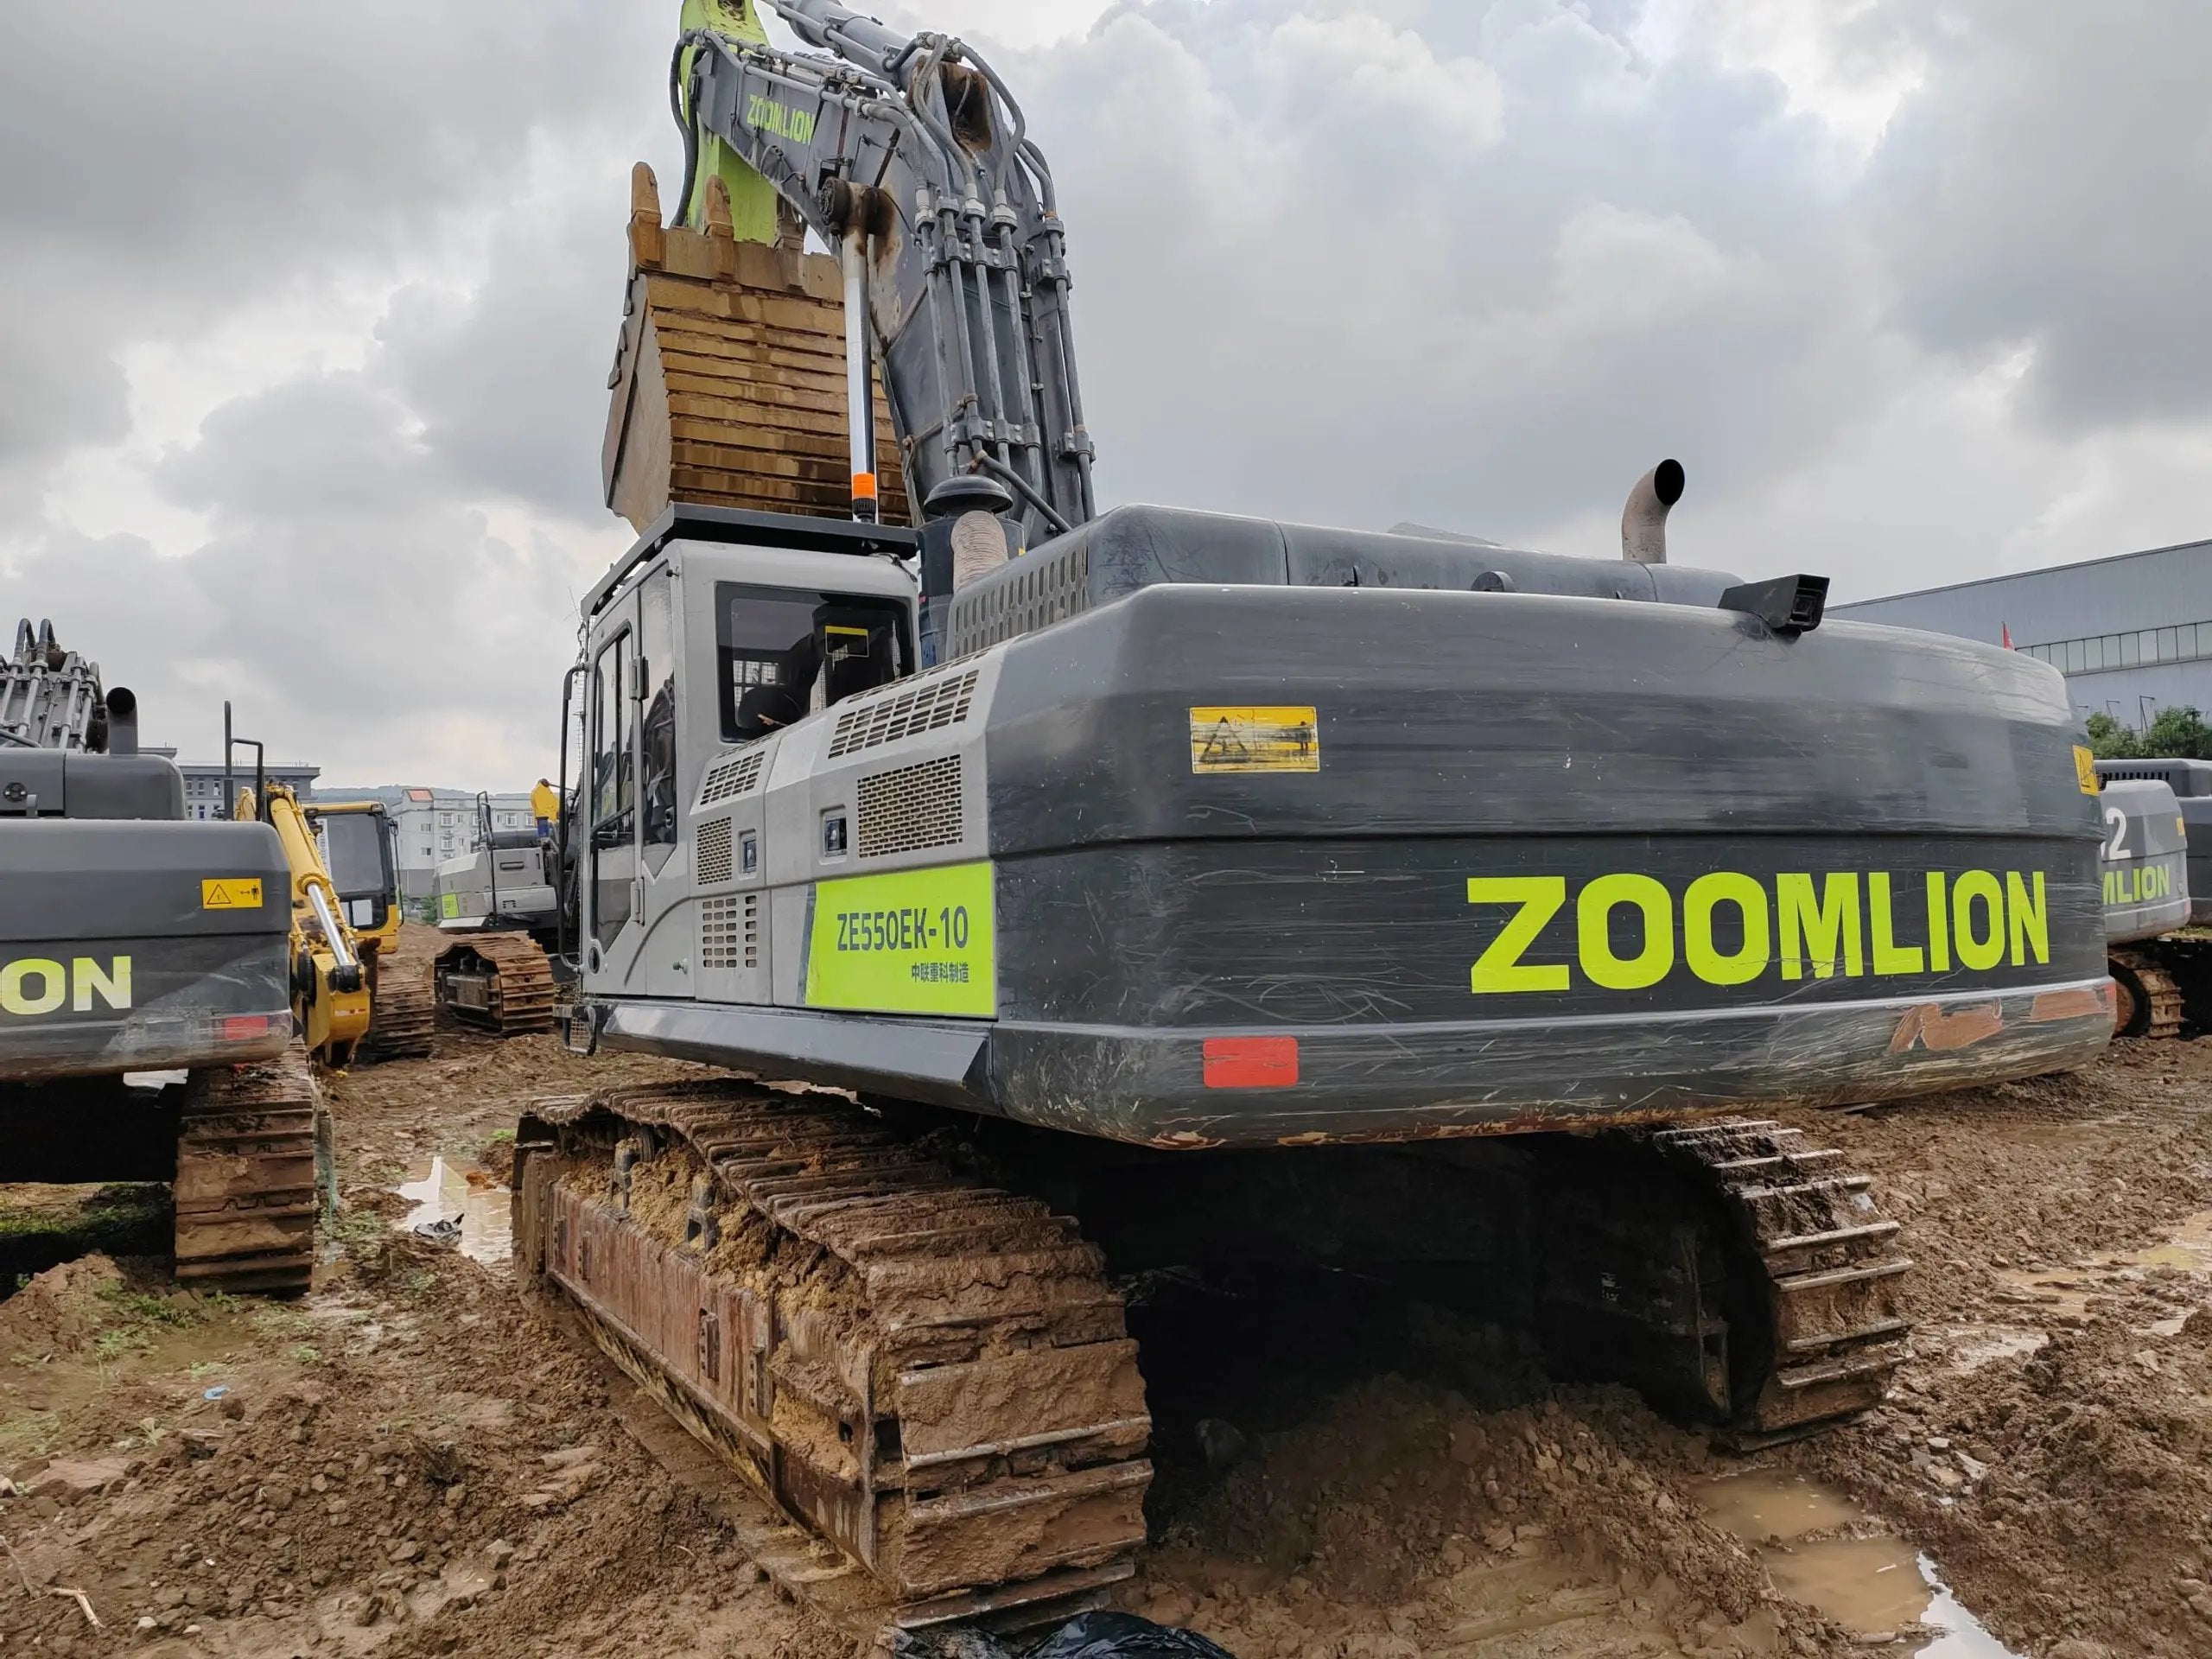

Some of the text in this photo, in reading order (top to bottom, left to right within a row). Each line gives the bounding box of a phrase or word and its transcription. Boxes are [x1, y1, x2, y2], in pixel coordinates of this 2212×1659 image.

[747, 93, 816, 146] ZOOMLION
[2101, 807, 2132, 860] 2
[837, 906, 969, 951] ZE550EK-10
[1467, 869, 2049, 994] ZOOMLION
[911, 962, 969, 983] 中联重科制造
